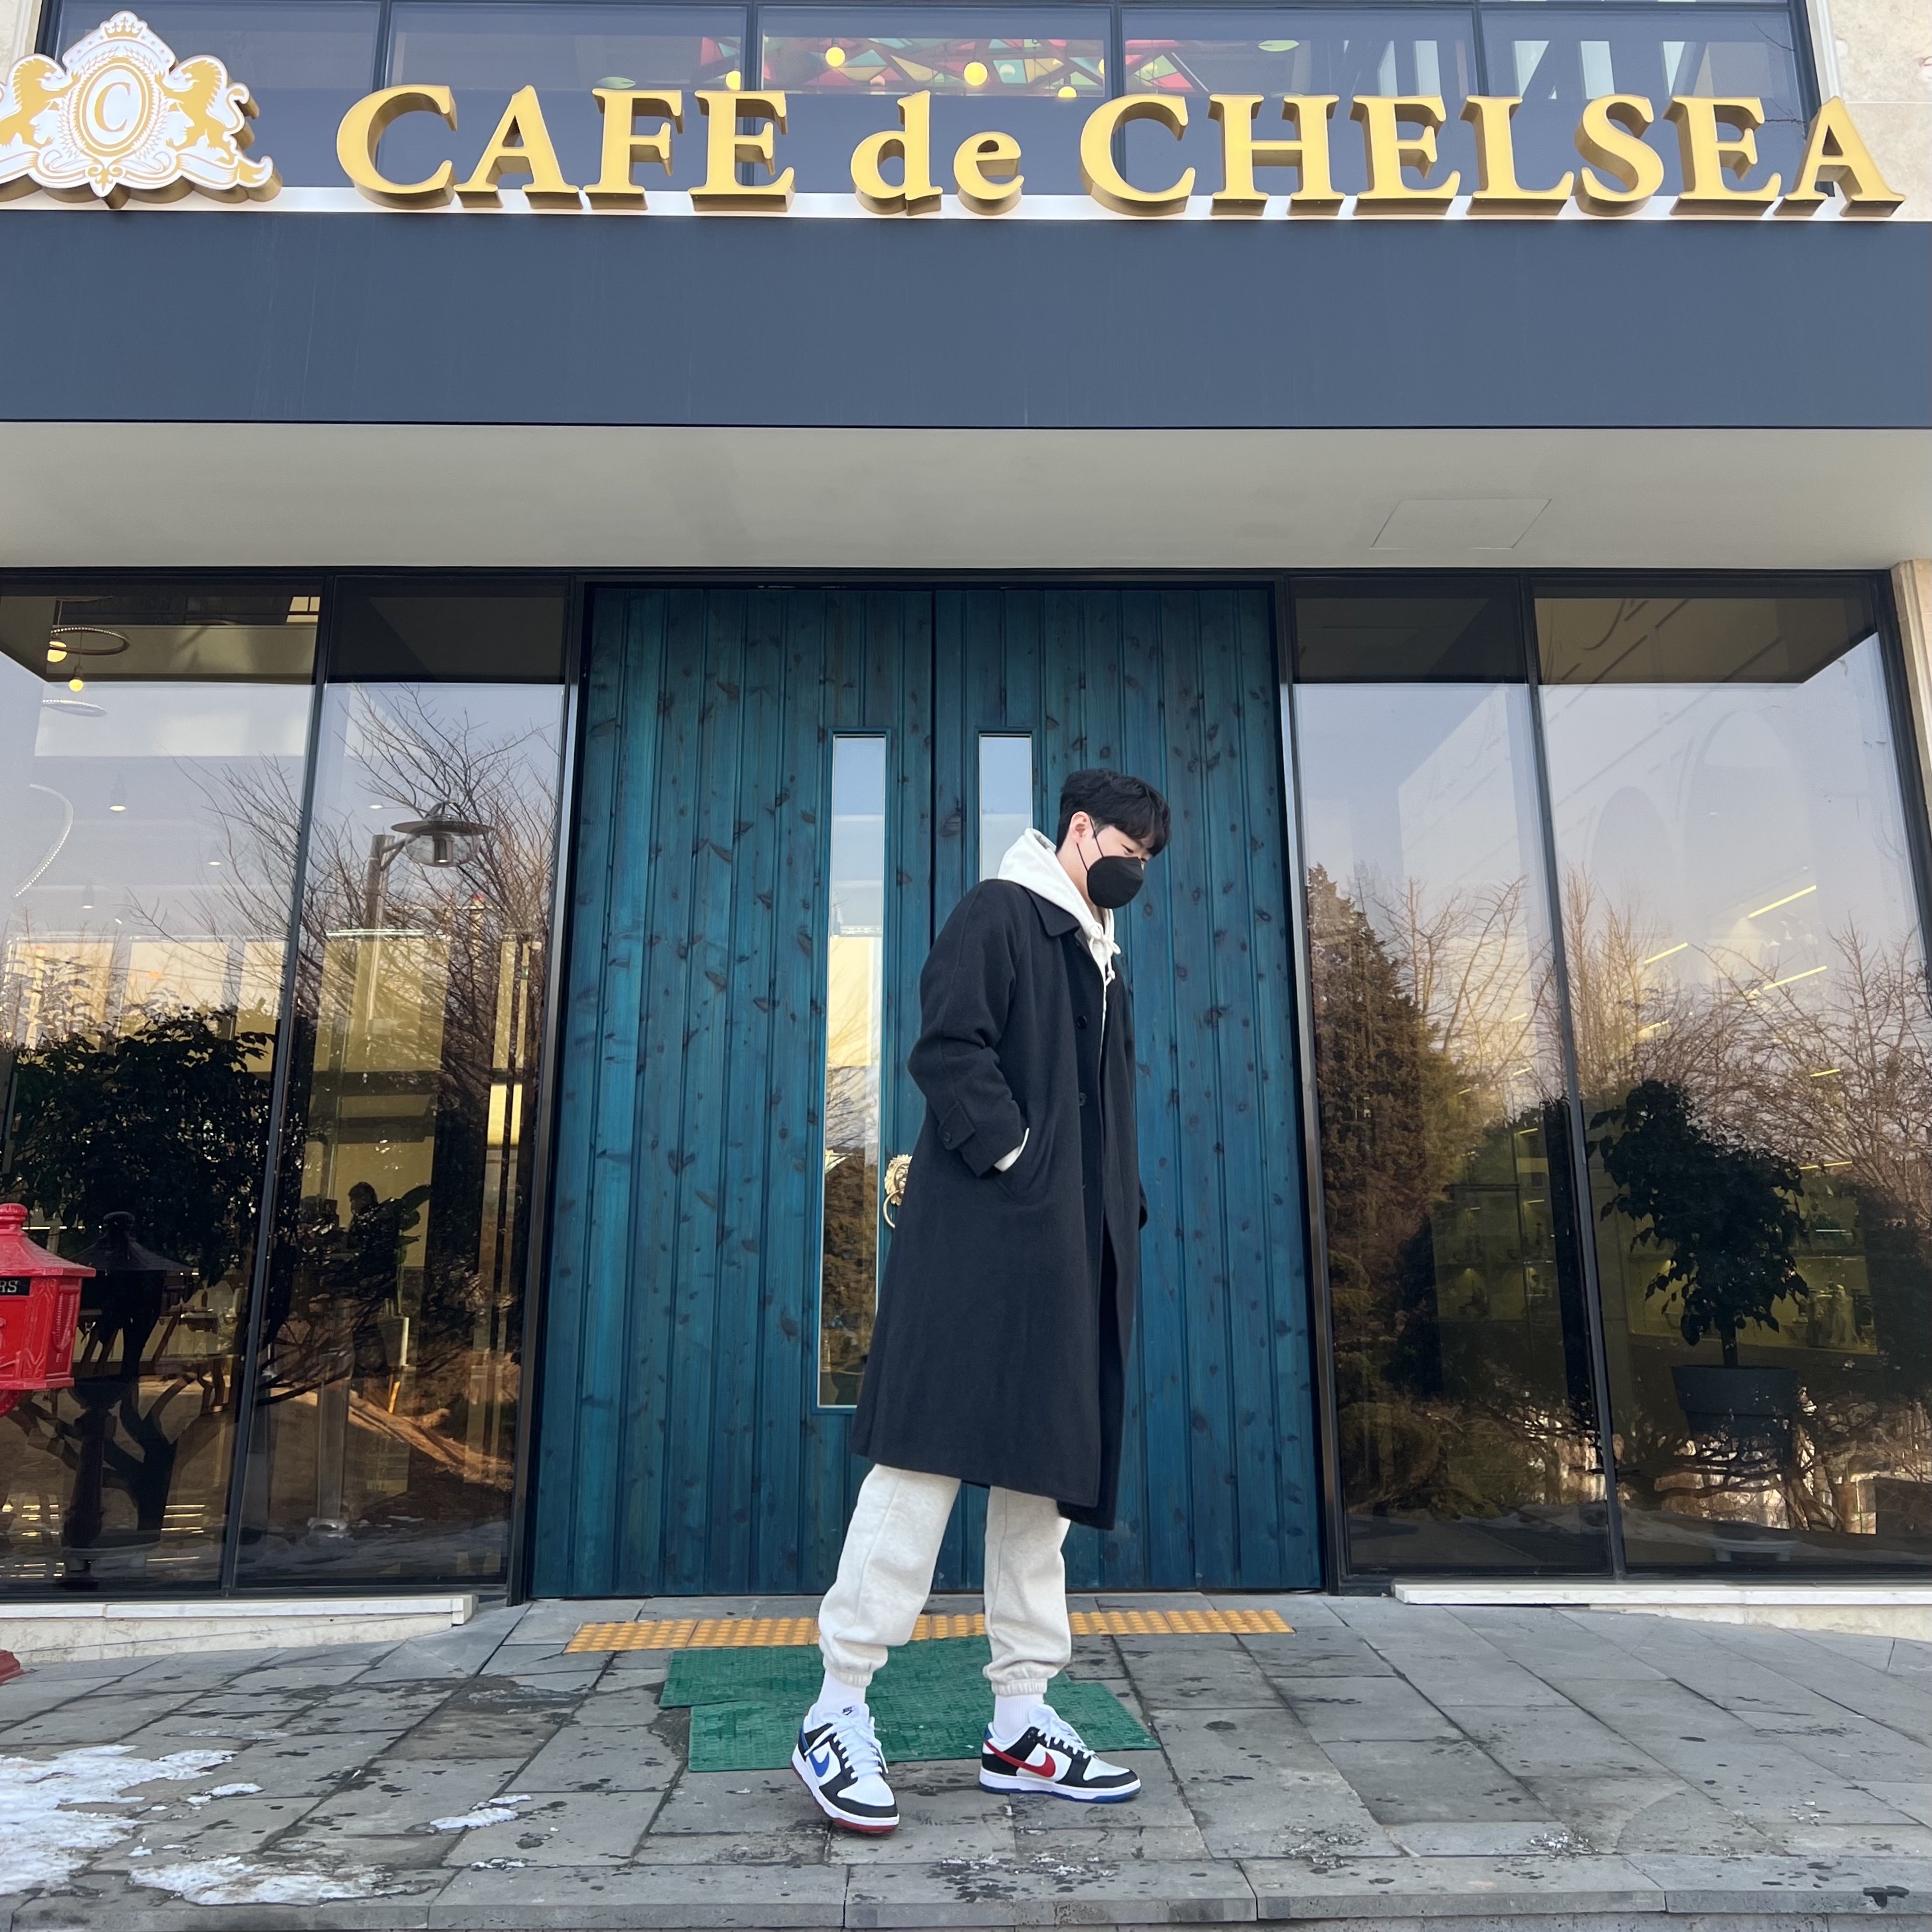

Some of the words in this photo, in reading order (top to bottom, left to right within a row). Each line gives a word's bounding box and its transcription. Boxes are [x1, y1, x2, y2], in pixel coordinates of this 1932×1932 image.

[94, 82, 131, 132] C
[336, 84, 796, 201] CAFE
[850, 90, 1025, 205] de
[1079, 94, 1907, 205] CHELSEA
